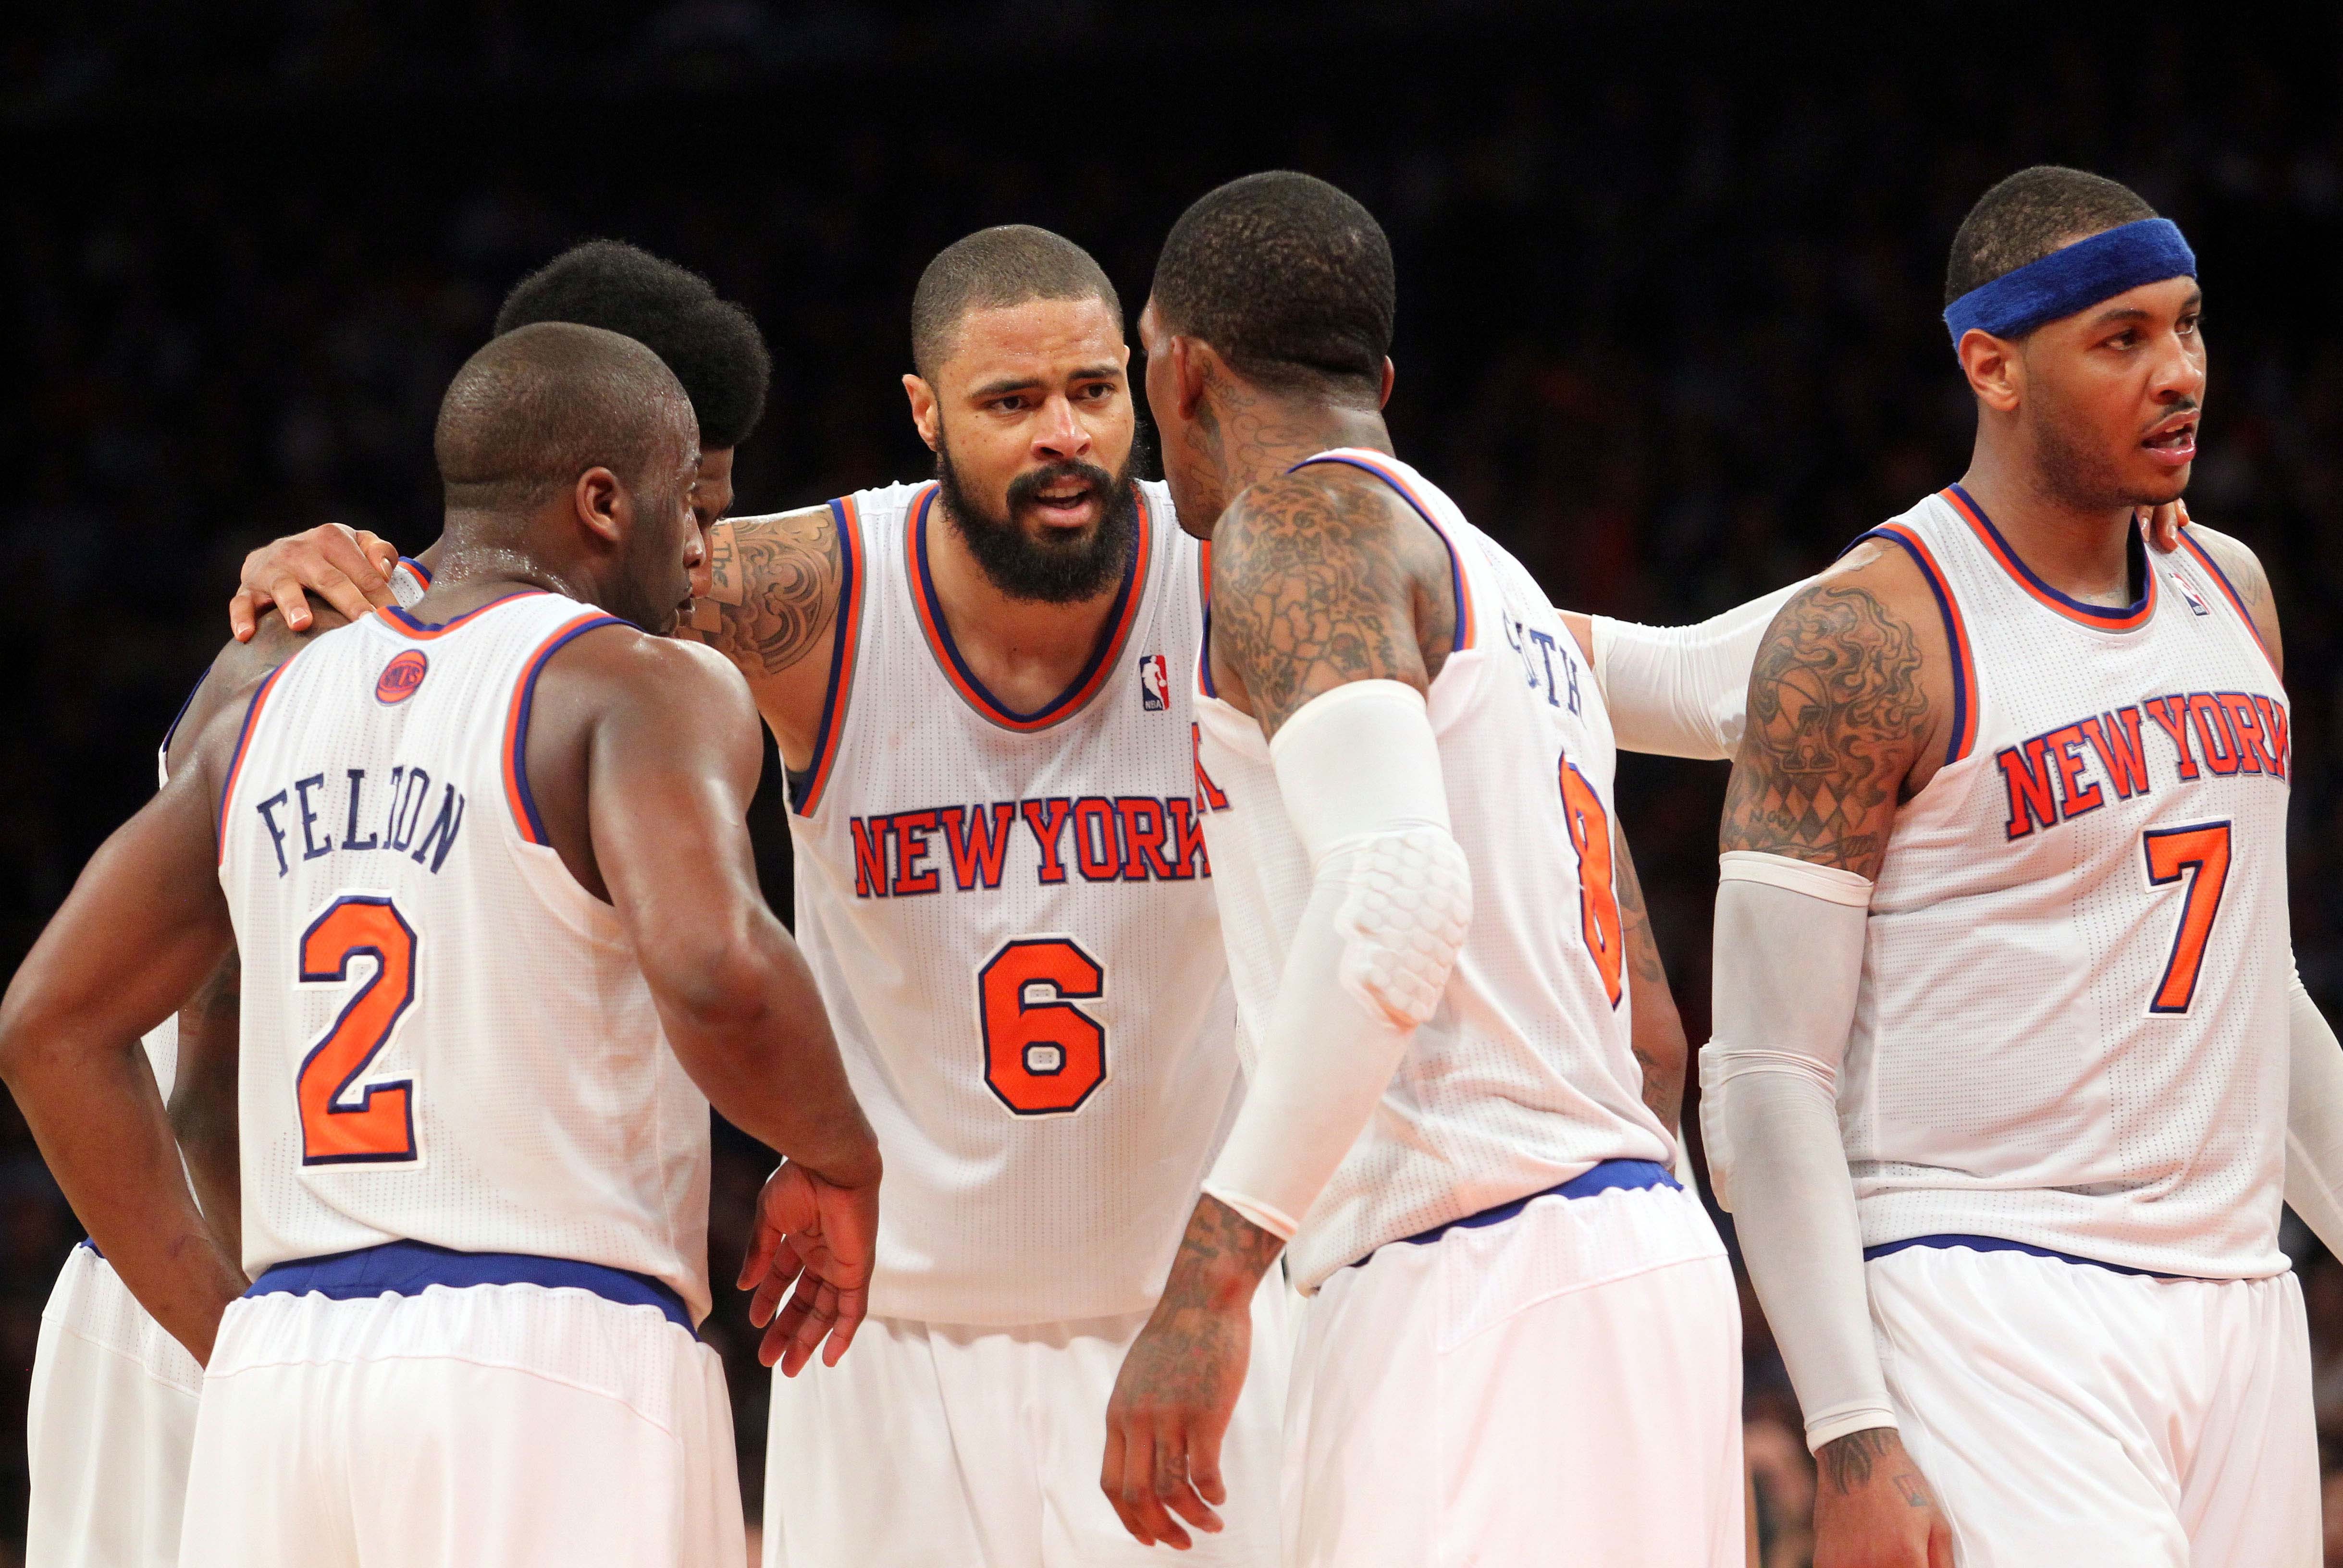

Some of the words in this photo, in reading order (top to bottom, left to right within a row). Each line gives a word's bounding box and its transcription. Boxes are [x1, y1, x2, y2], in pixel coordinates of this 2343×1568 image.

[1145, 699, 1162, 710] NBA
[1997, 705, 2150, 841] NEW
[2144, 692, 2291, 784] YORK
[850, 802, 1015, 898] NEW
[1021, 796, 1212, 884] YORK
[1559, 747, 1622, 1010] 8
[2143, 820, 2231, 1014] 7
[296, 895, 418, 1166] 2
[978, 938, 1106, 1115] 6
